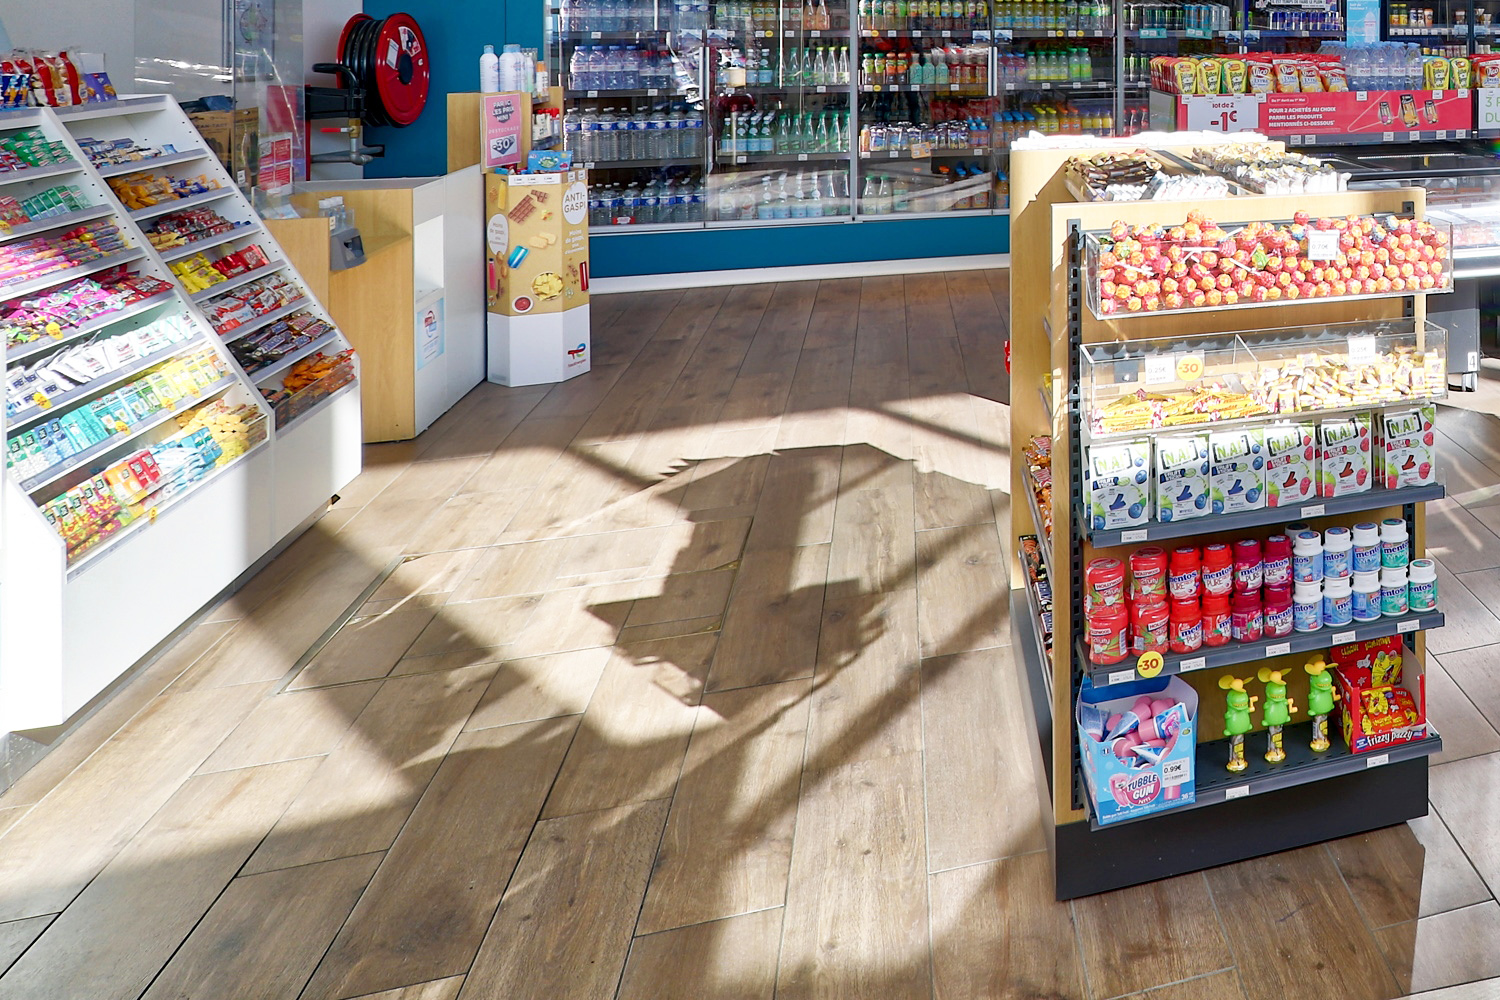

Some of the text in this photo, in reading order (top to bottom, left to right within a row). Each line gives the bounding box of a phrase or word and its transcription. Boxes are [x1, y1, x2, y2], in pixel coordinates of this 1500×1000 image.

[1486, 96, 1492, 107] 3
[564, 193, 586, 203] ANTI-
[563, 202, 587, 213] GASPI
[1178, 362, 1199, 373] -30
[1469, 354, 1476, 369] 4
[1203, 566, 1234, 580] mentos
[1138, 658, 1160, 671] -30
[1367, 729, 1413, 747] frizzy pazzy
[1164, 764, 1182, 774] 0.99€
[1127, 773, 1158, 792] TUBBLE
[1132, 784, 1155, 799] GUM
